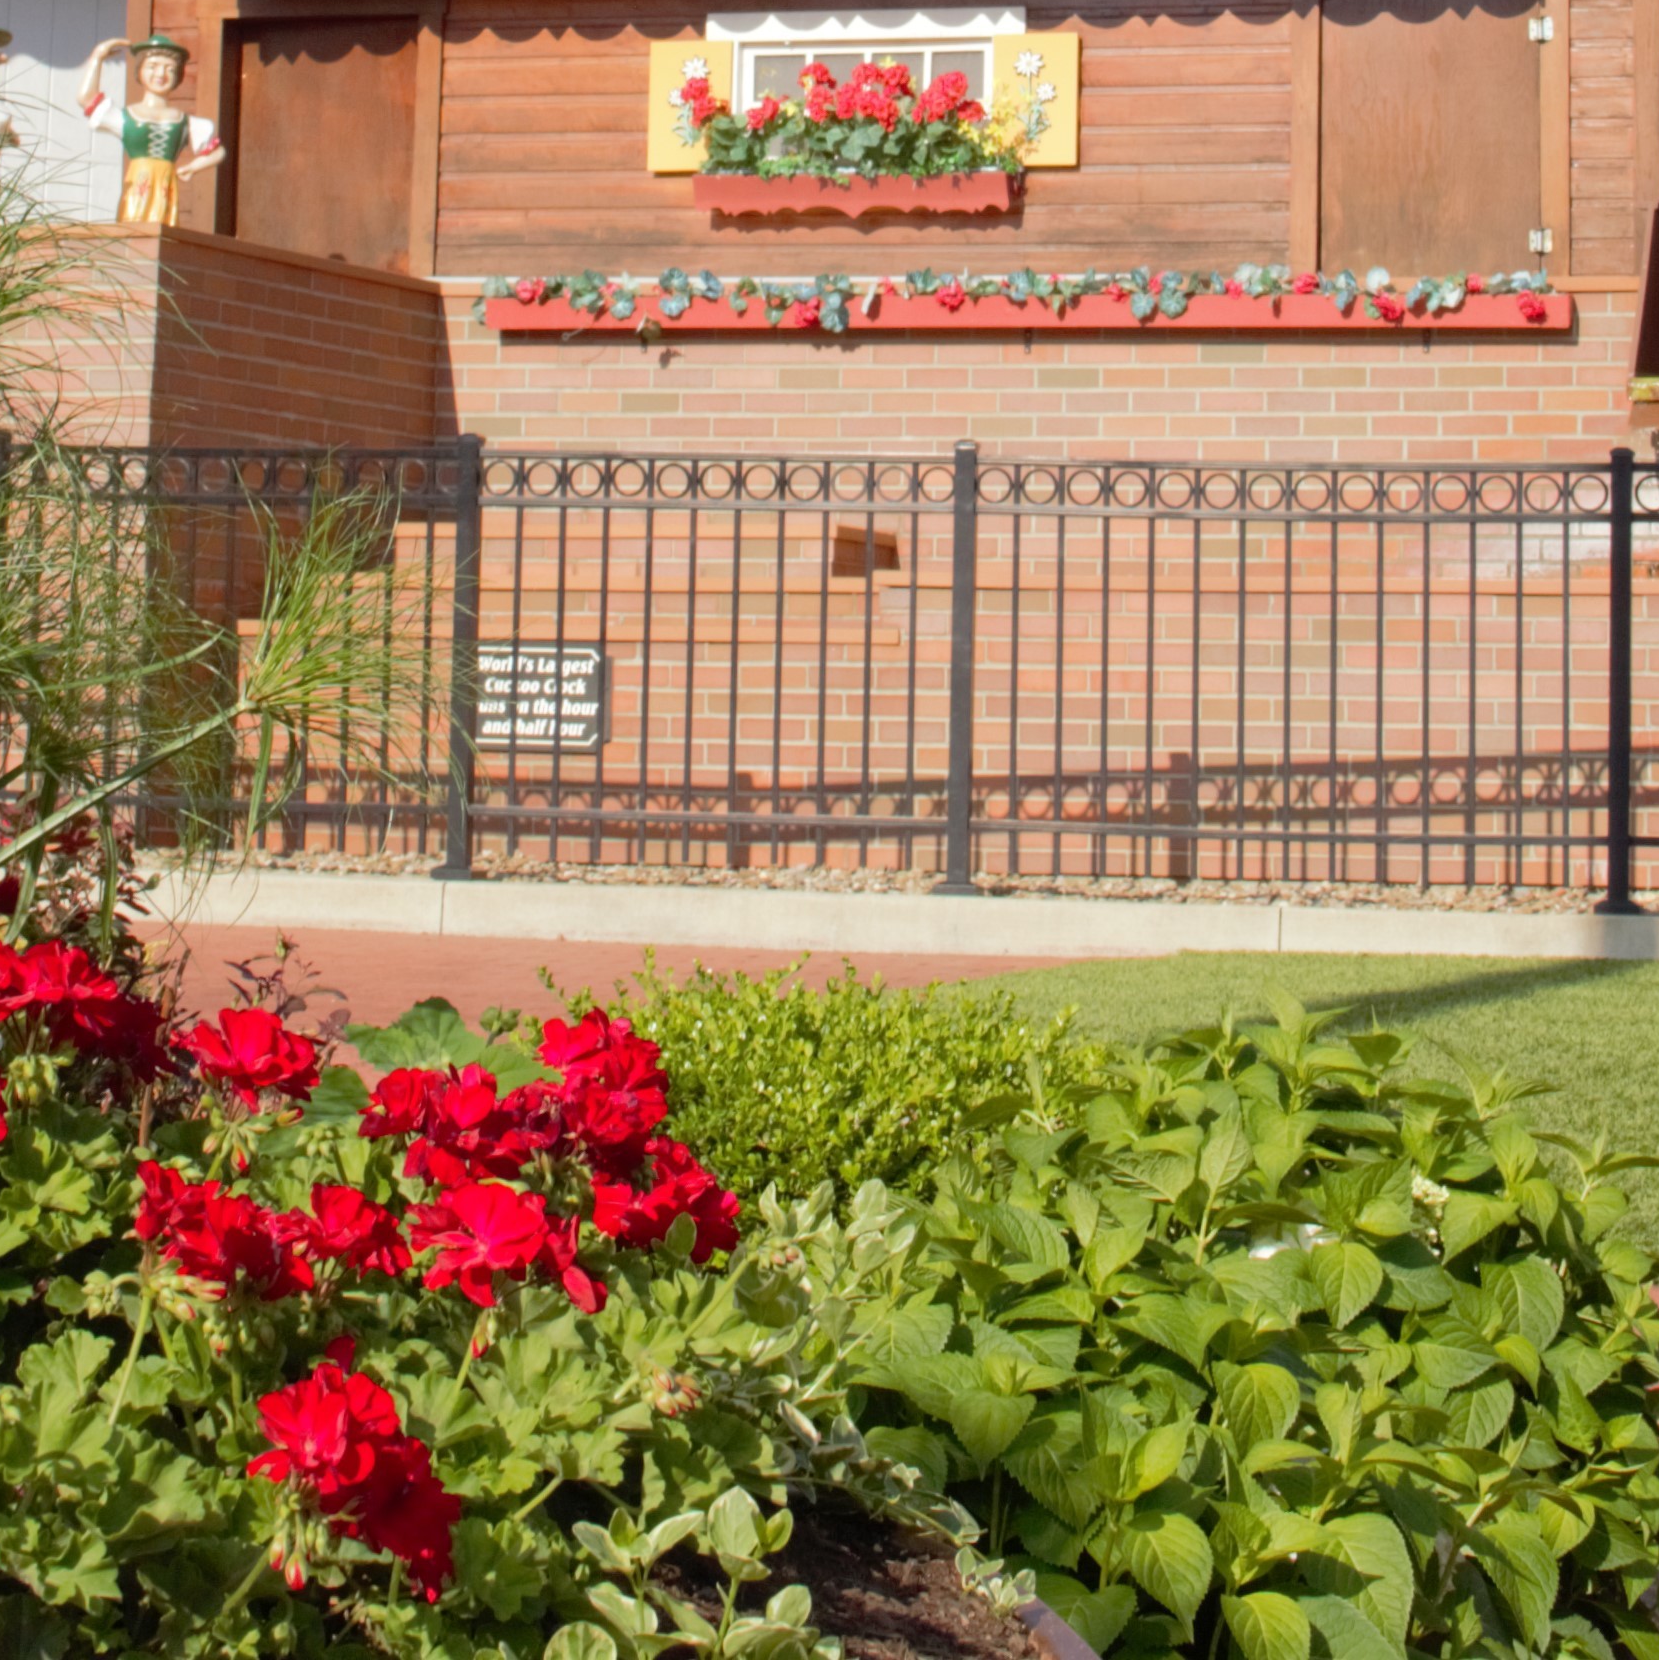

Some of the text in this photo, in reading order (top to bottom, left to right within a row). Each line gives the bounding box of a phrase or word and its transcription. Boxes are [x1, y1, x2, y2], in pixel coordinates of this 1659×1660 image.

[537, 657, 595, 678] Lagest
[484, 677, 540, 695] Cucoo
[510, 699, 529, 715] n
[561, 698, 599, 716] hour
[482, 718, 512, 736] and
[515, 718, 548, 737] half
